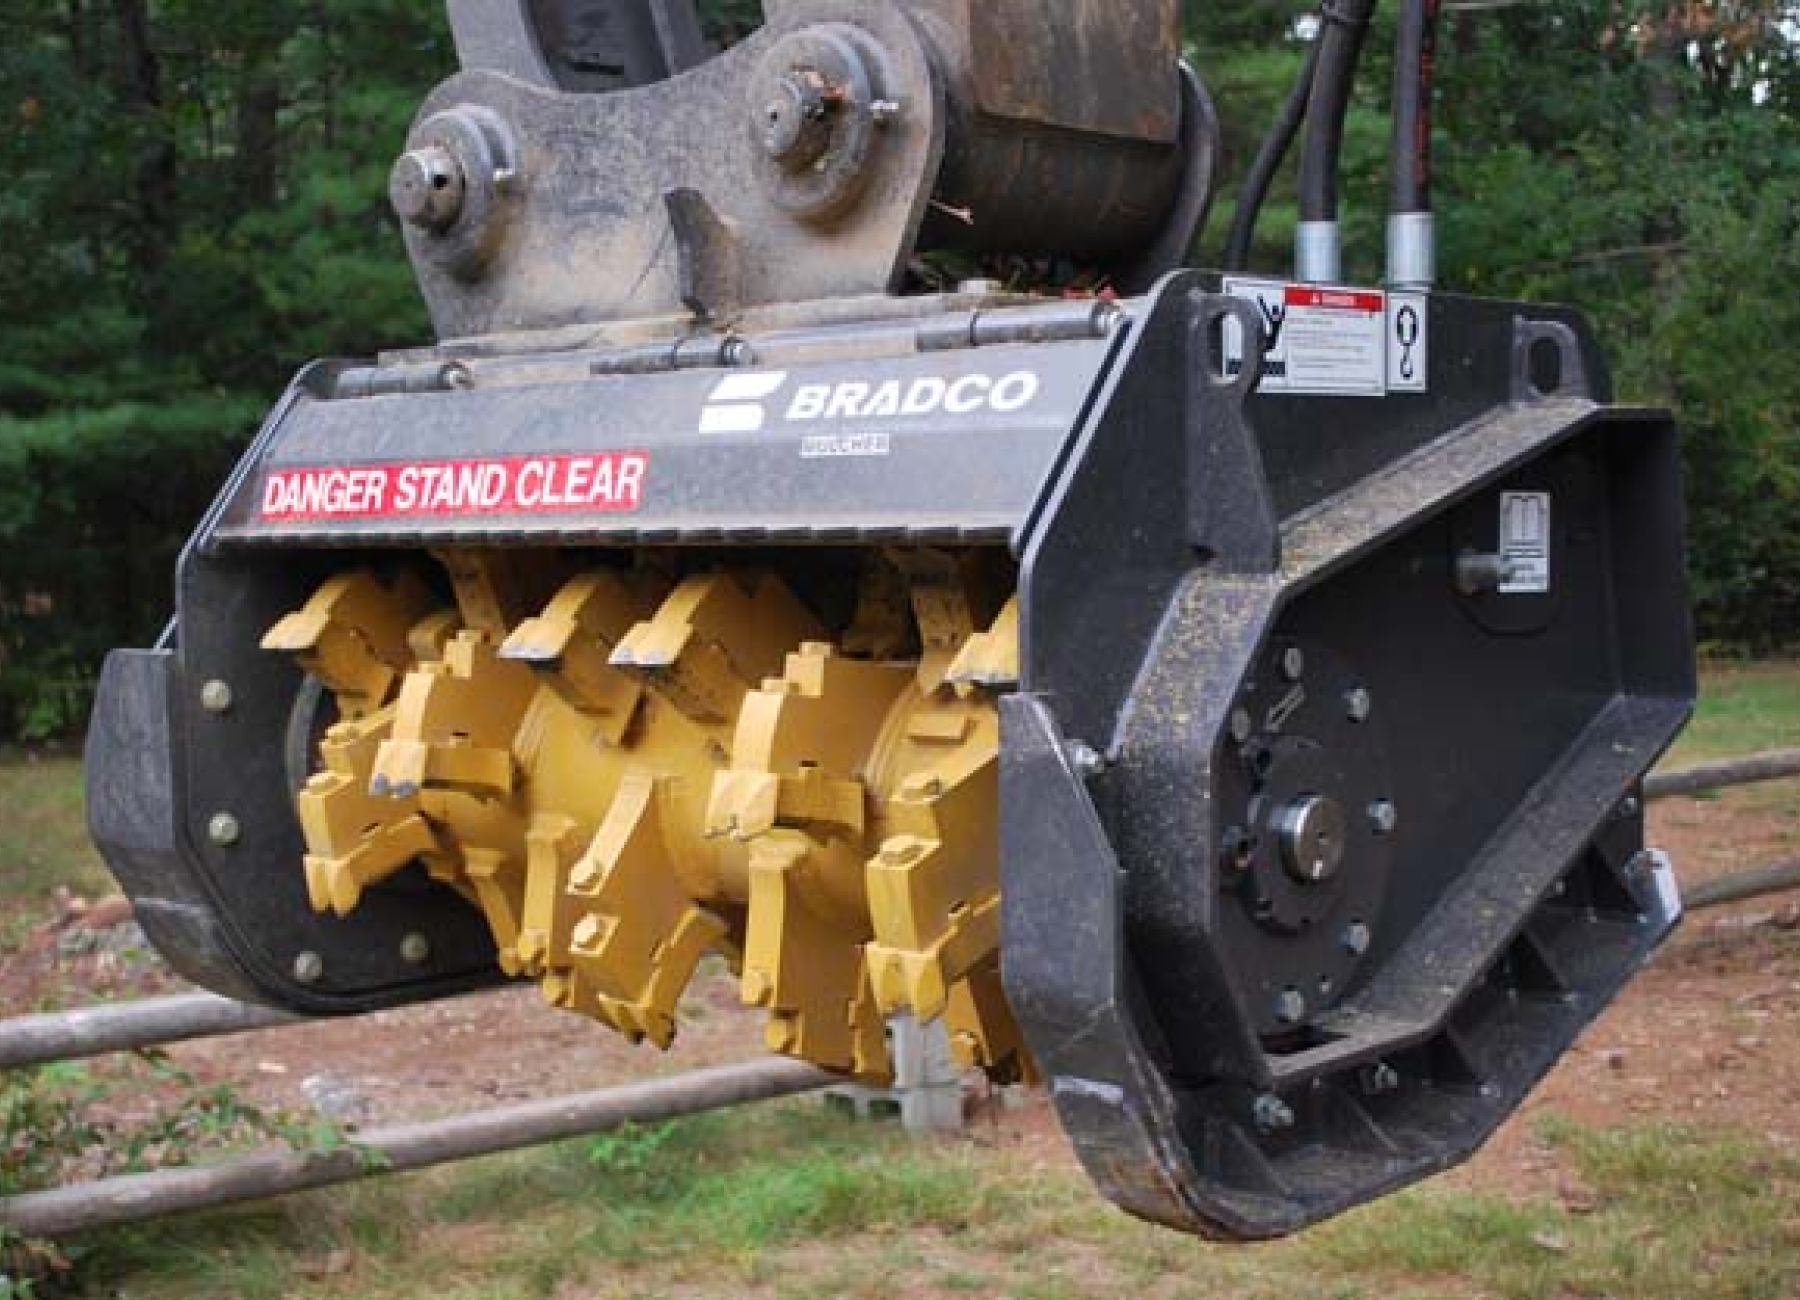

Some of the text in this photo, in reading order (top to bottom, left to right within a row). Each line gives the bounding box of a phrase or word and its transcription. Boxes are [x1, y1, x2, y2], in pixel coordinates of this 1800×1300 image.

[786, 371, 1039, 420] BRADCO
[262, 456, 646, 514] DANGER STAND CLEAR
